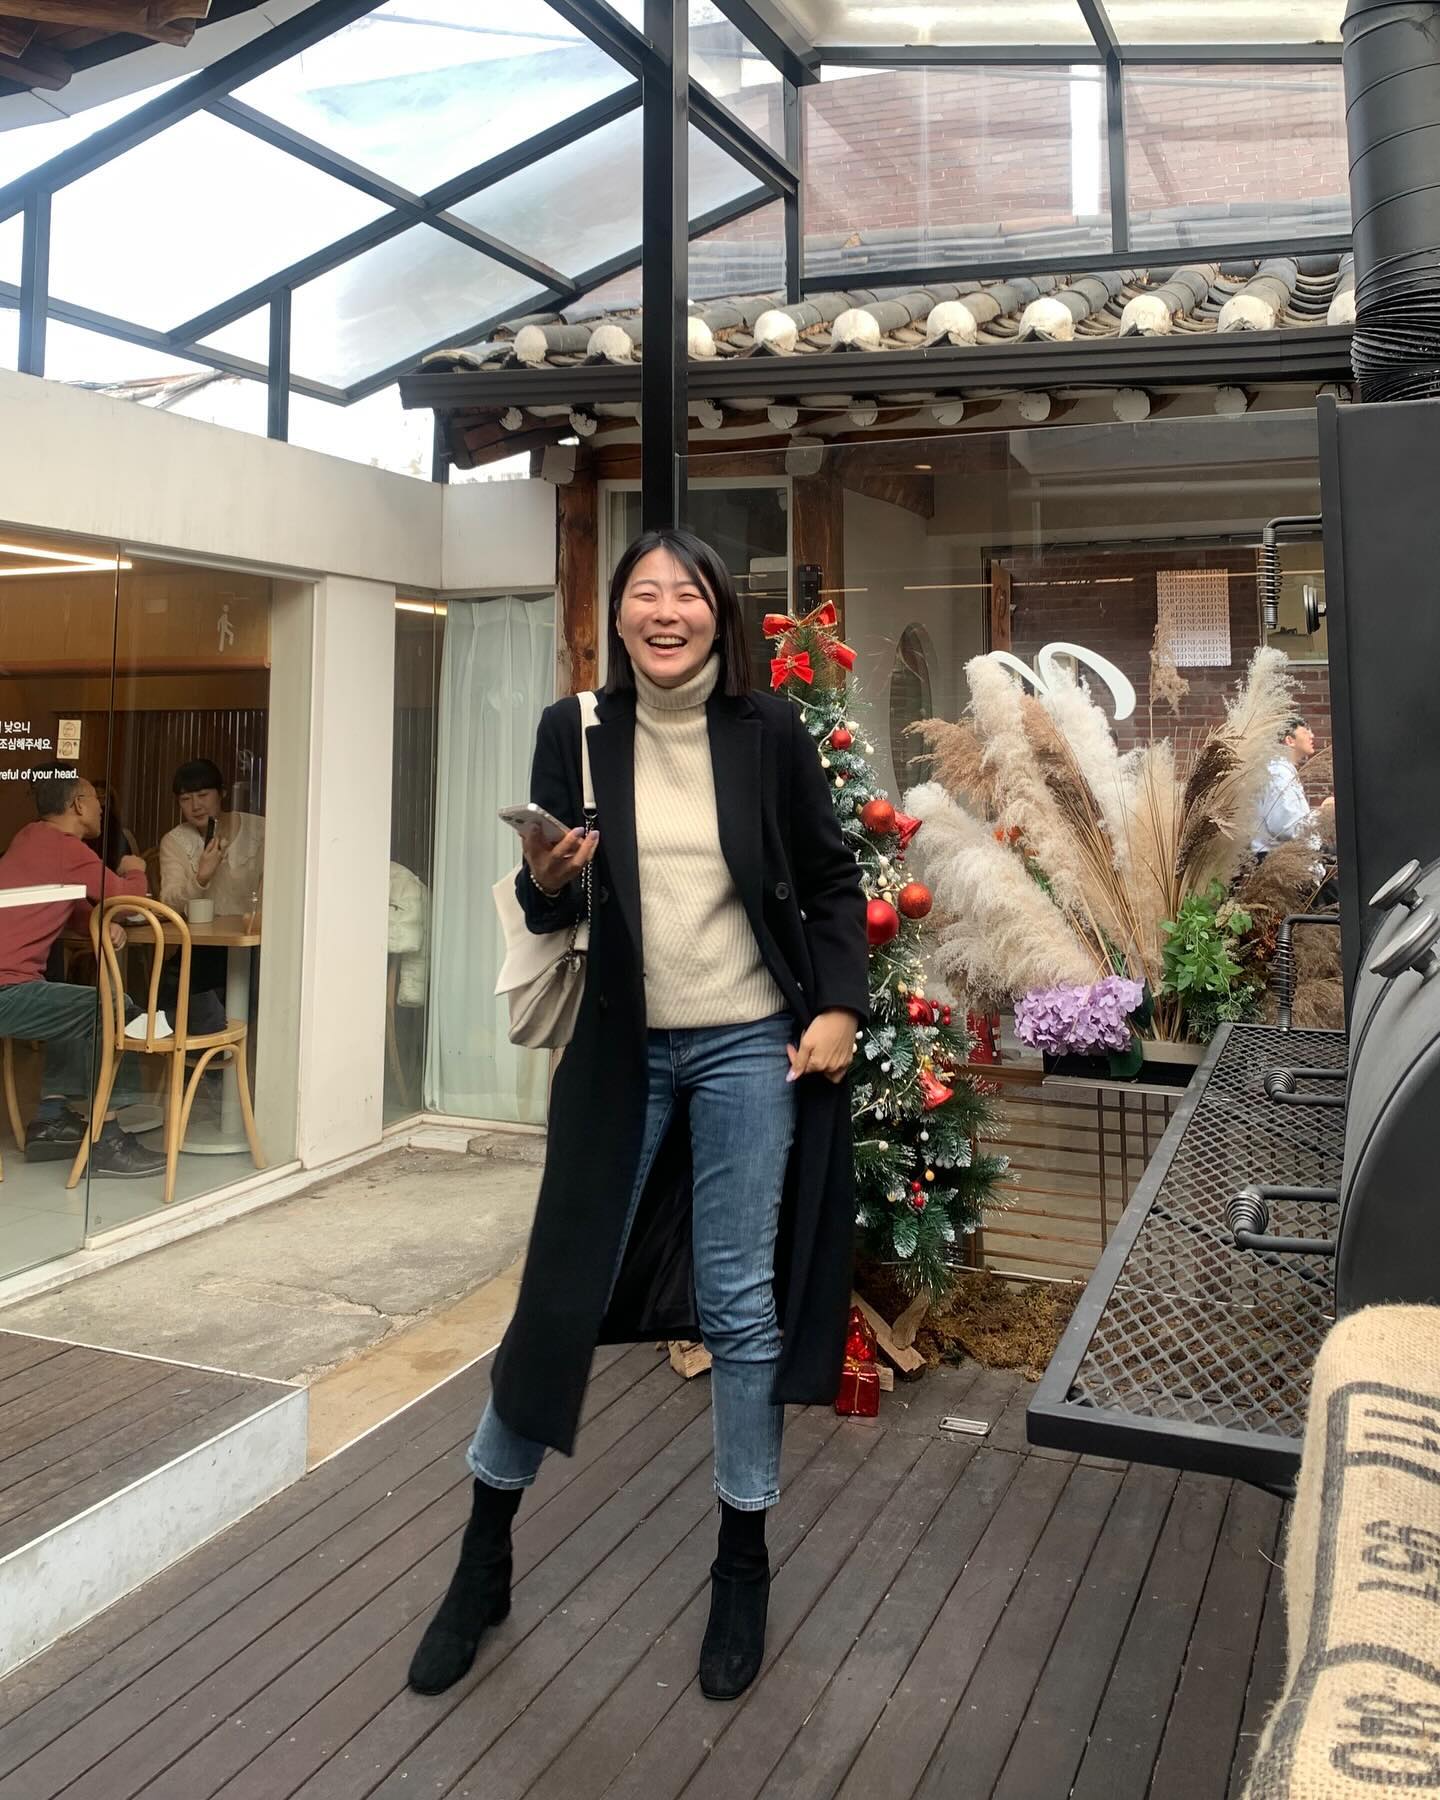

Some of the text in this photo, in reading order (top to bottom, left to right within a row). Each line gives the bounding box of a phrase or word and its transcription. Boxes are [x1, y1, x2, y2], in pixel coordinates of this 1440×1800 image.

[4, 721, 31, 734] 낮으니
[0, 738, 53, 751] 조심해주세요.
[20, 768, 31, 780] of
[32, 770, 53, 783] your
[54, 768, 79, 779] head.
